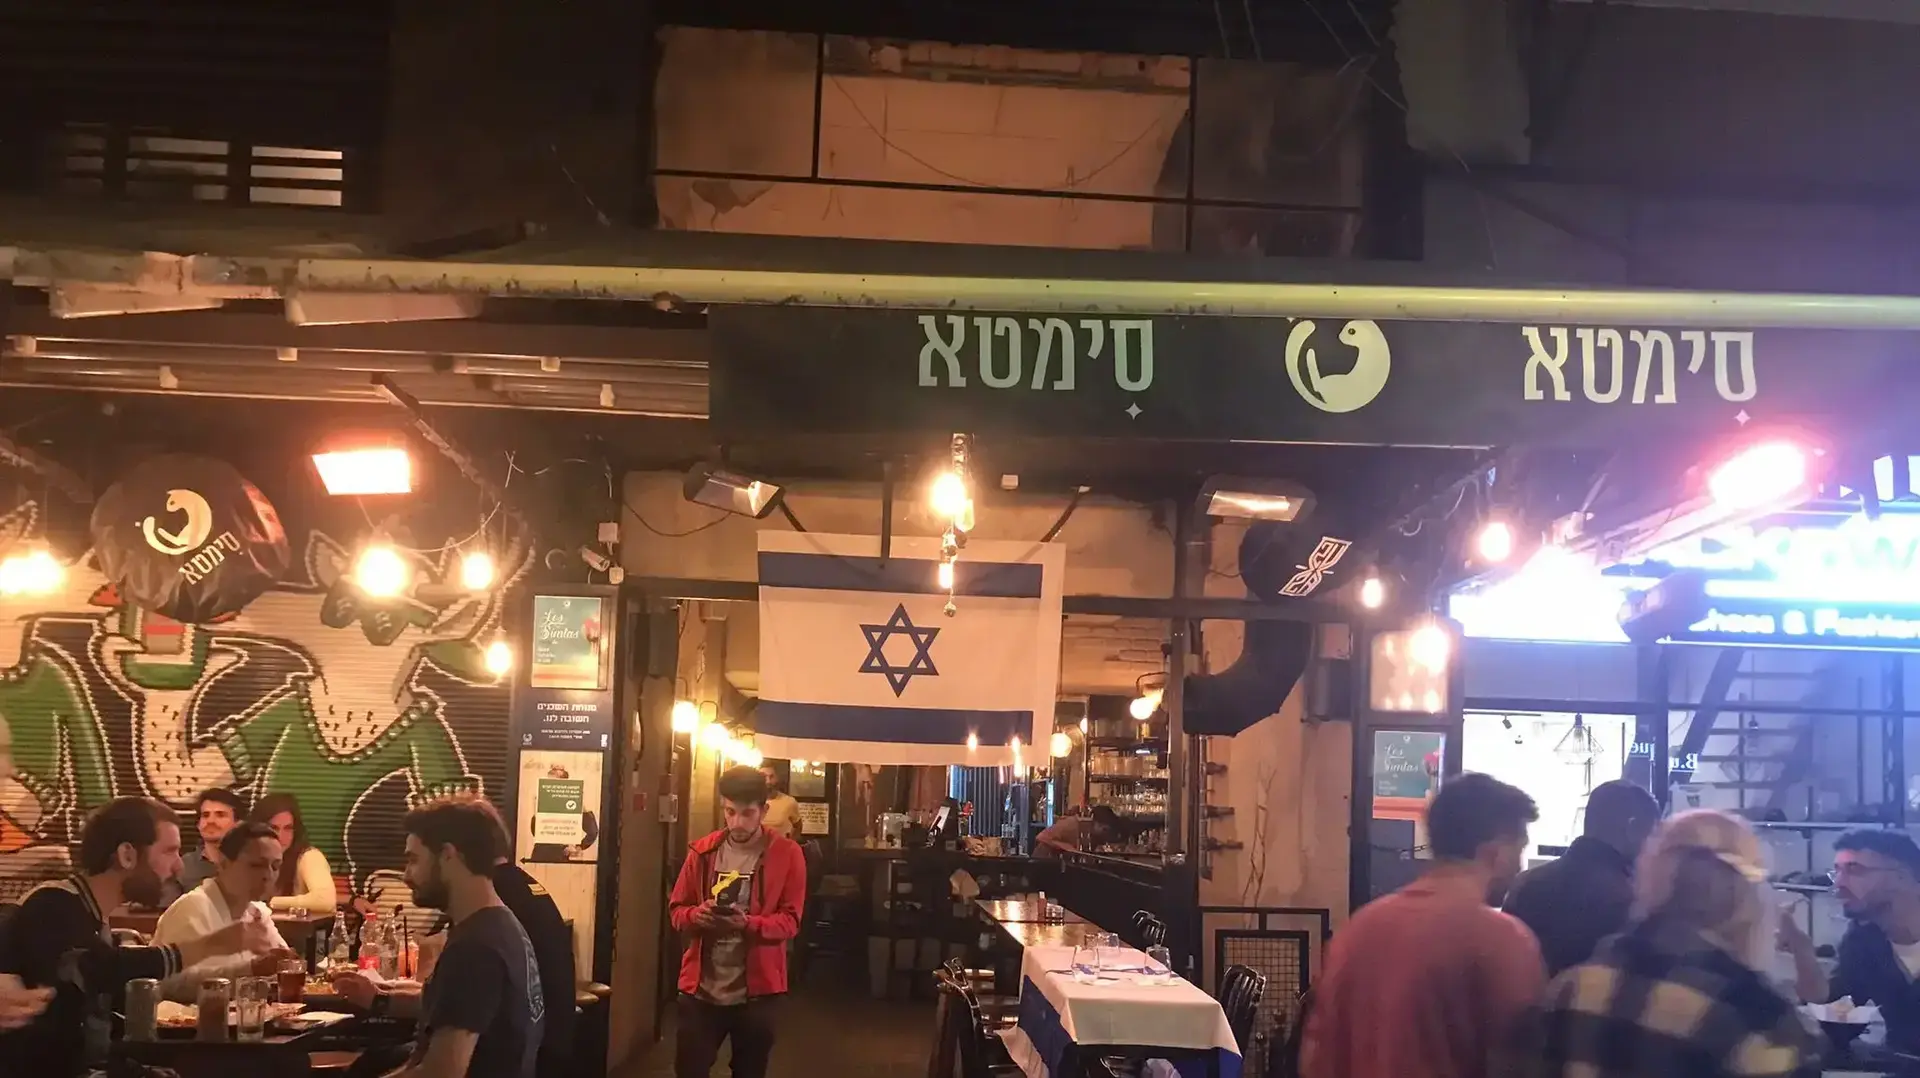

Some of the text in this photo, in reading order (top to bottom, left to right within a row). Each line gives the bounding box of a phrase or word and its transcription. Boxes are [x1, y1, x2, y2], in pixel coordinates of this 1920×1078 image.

[917, 314, 1153, 392] סימטא
[1522, 326, 1757, 404] סימטא
[178, 531, 240, 585] סימטא
[1783, 609, 1807, 634] &
